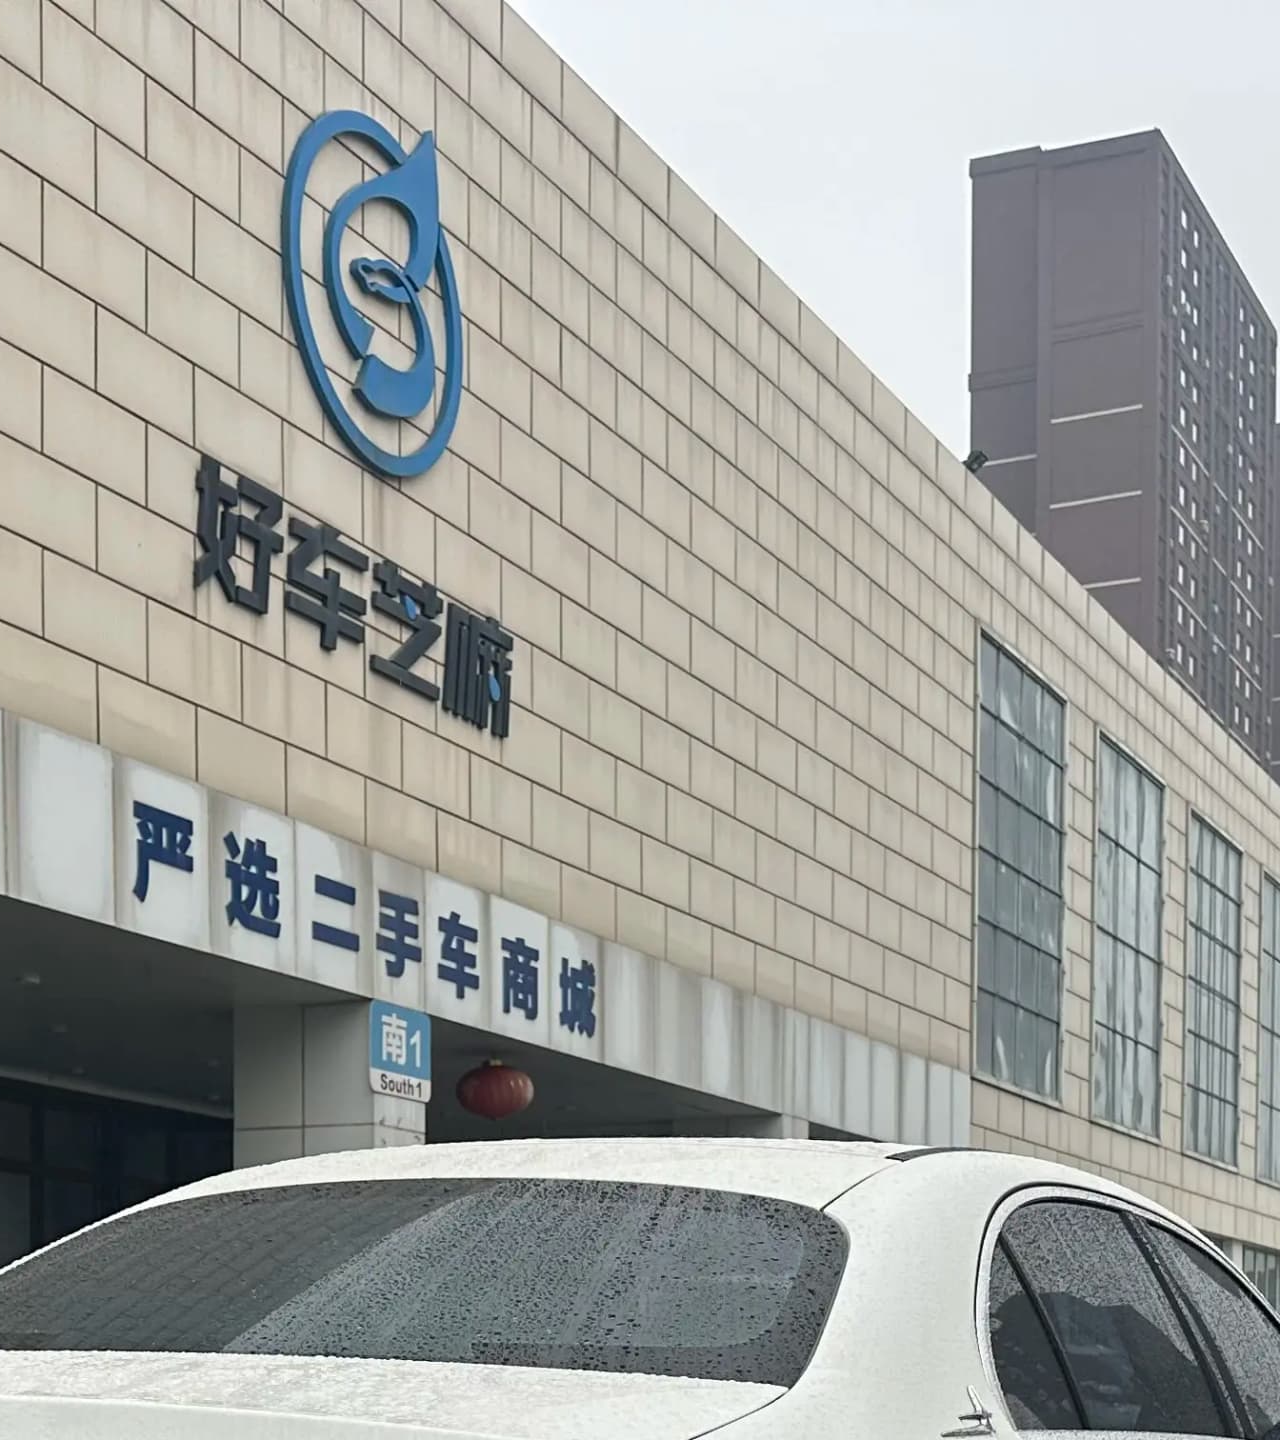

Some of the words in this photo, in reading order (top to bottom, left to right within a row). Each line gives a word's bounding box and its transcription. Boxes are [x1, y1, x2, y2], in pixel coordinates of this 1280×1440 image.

[132, 800, 597, 1038] 严选二手车商城
[381, 1013, 421, 1068] 南1
